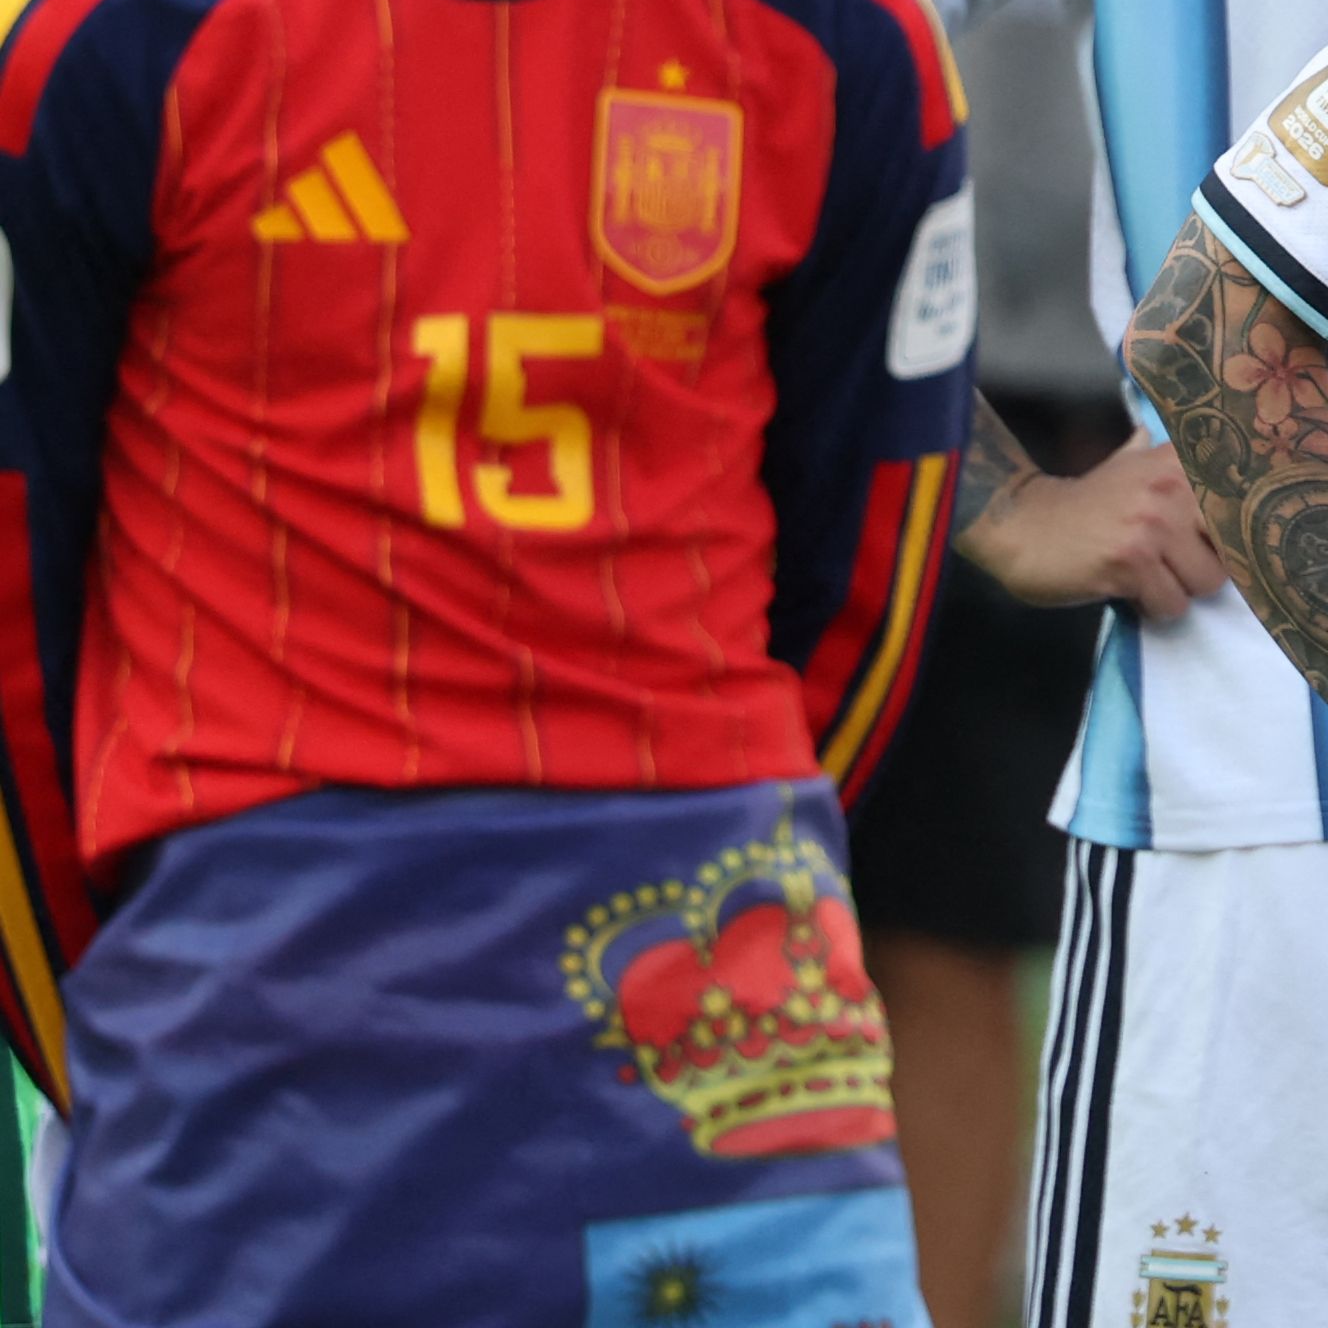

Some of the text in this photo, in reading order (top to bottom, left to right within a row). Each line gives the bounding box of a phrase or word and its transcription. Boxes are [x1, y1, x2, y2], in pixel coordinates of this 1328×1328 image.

[1281, 114, 1325, 159] 2026
[412, 311, 604, 531] 15
[1149, 1281, 1209, 1328] AFA
